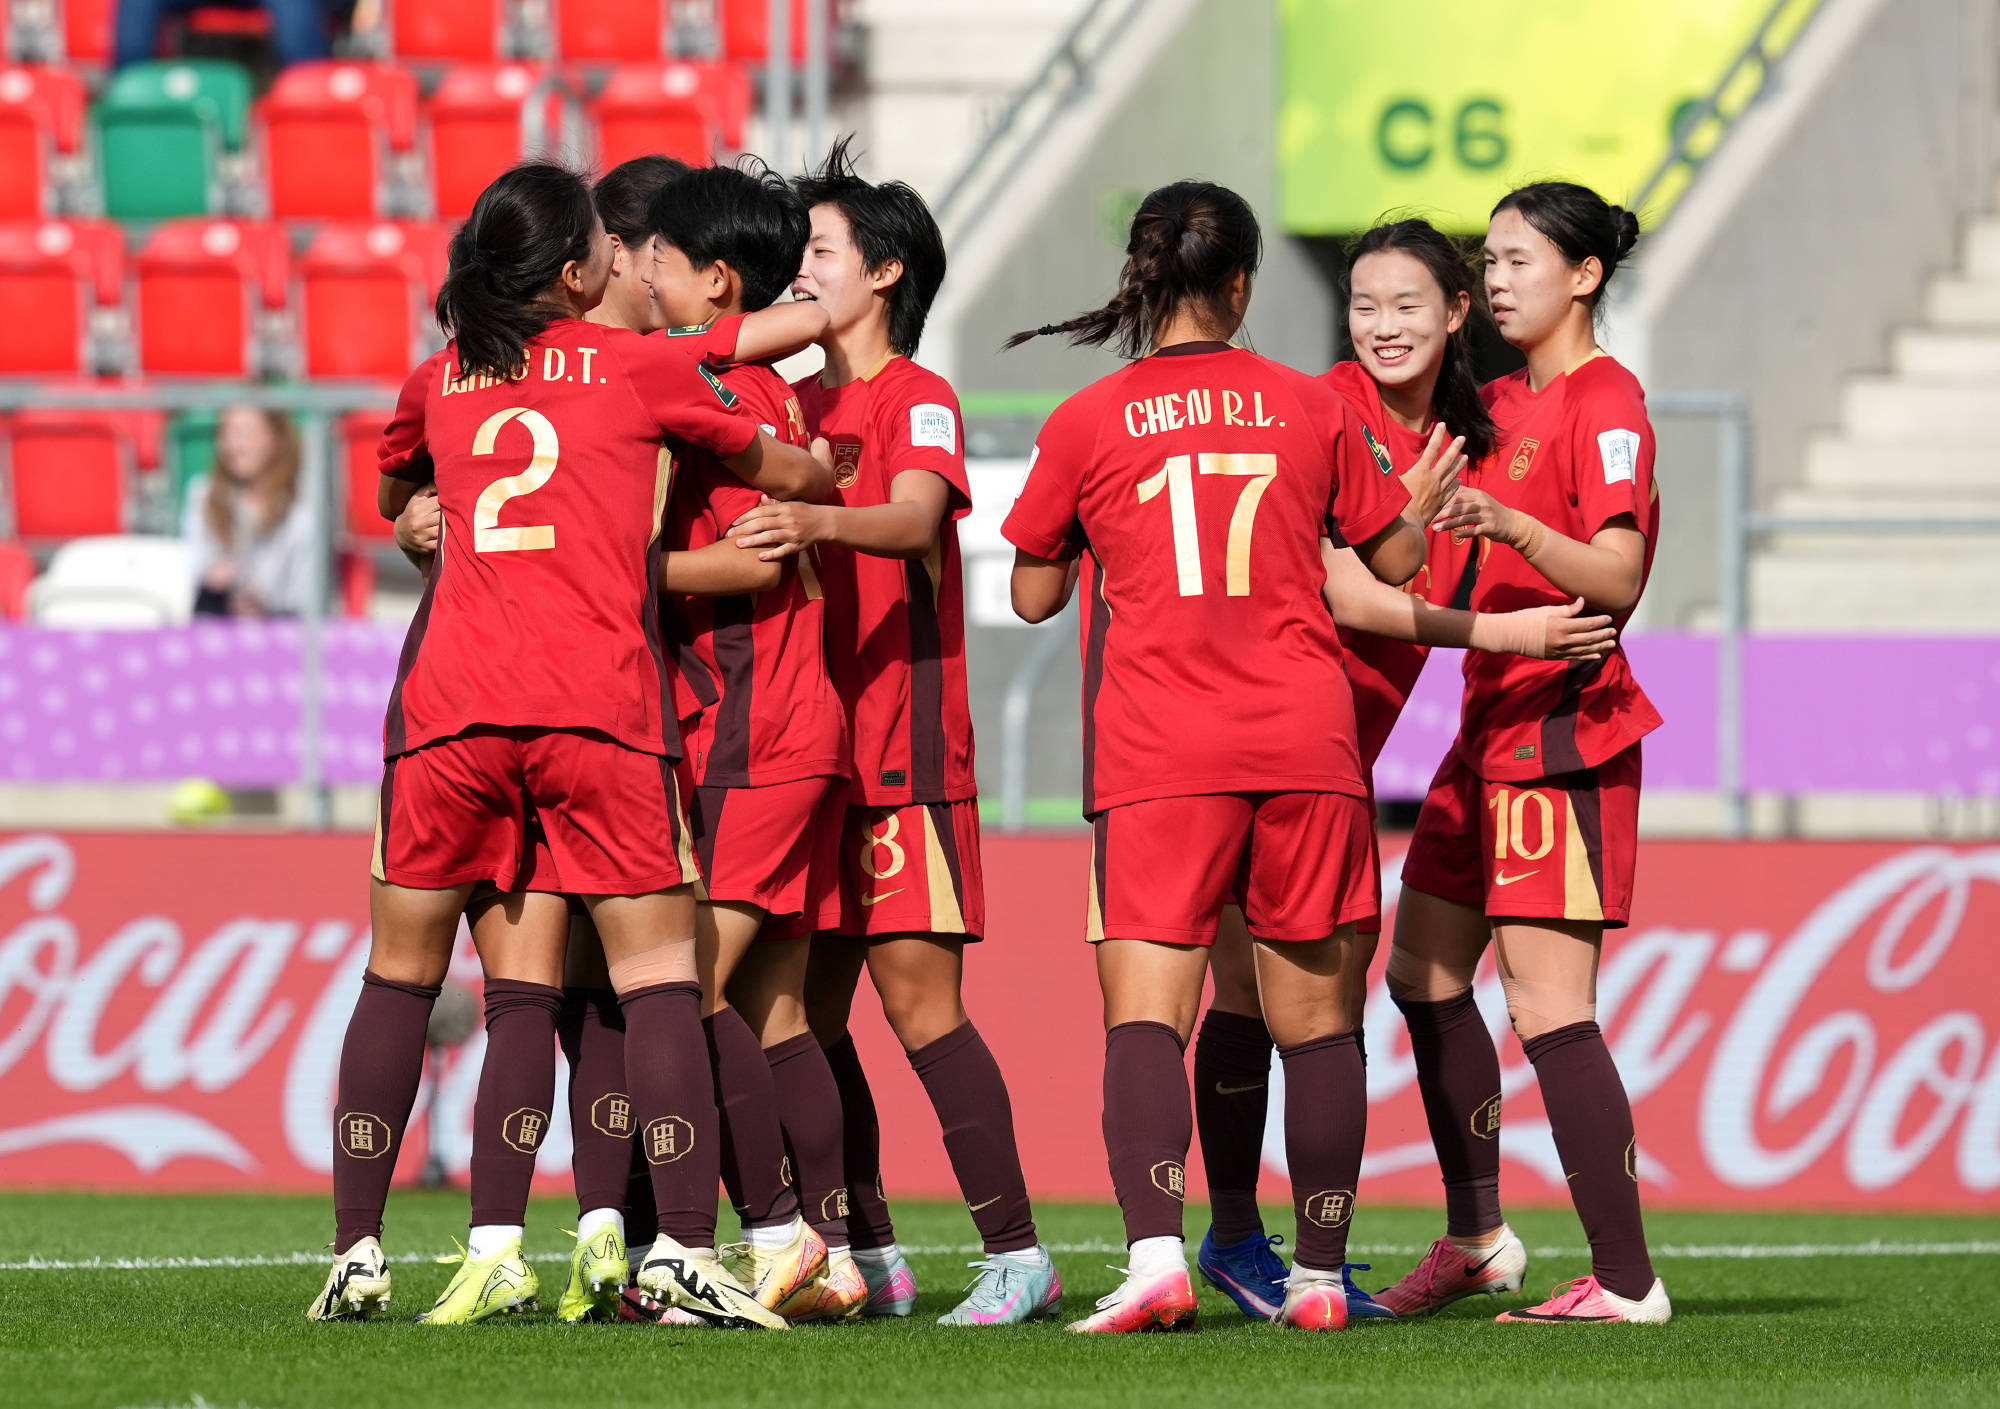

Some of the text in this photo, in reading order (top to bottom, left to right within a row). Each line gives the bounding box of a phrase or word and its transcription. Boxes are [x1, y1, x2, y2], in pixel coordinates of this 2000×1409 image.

[1379, 100, 1508, 170] C6
[543, 347, 607, 384] D.T.
[1124, 388, 1286, 438] CHEN R.L.
[837, 447, 860, 456] CFA
[472, 407, 559, 553] 2
[1136, 452, 1277, 597] 17
[1488, 789, 1554, 860] 10
[860, 808, 905, 879] 8
[519, 1114, 542, 1147] 中国
[609, 1099, 630, 1131] 中国
[350, 1119, 373, 1151] 中国
[653, 1123, 675, 1157] 中国
[1320, 1195, 1345, 1222] 中国
